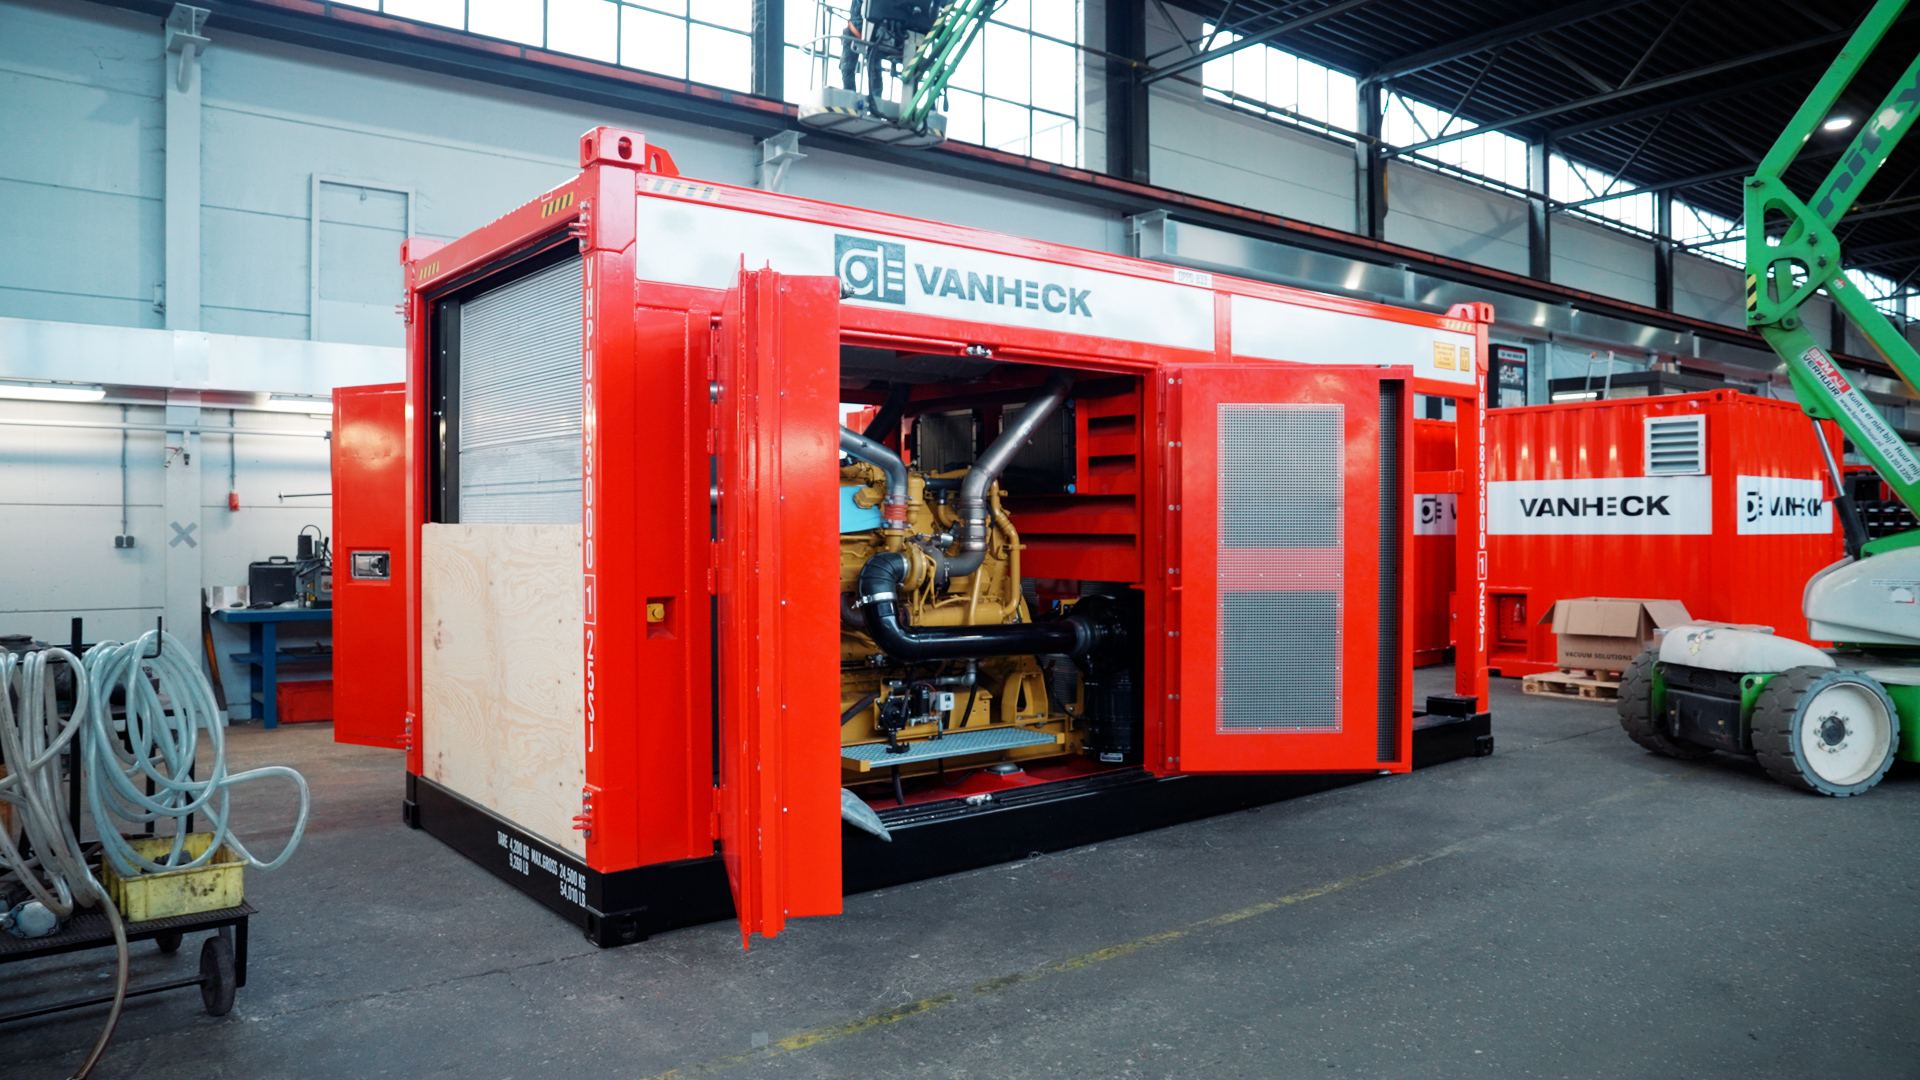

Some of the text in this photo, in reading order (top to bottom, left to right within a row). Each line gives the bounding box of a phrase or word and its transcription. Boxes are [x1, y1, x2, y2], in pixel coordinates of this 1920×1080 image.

[914, 263, 1092, 317] VANHECK
[1803, 354, 1841, 396] VERHUUR
[1847, 391, 1863, 409] Kunt
[1865, 412, 1873, 420] er
[1871, 420, 1886, 434] niet
[1882, 431, 1897, 445] bij?
[1894, 446, 1911, 463] Huur
[1520, 495, 1671, 517] VANHECK
[1565, 651, 1632, 661] VACUUM SOLUTIONS
[497, 831, 508, 849] TARE
[523, 844, 530, 860] KG
[578, 873, 586, 891] KG
[523, 860, 529, 876] LB
[579, 892, 586, 908] LB
